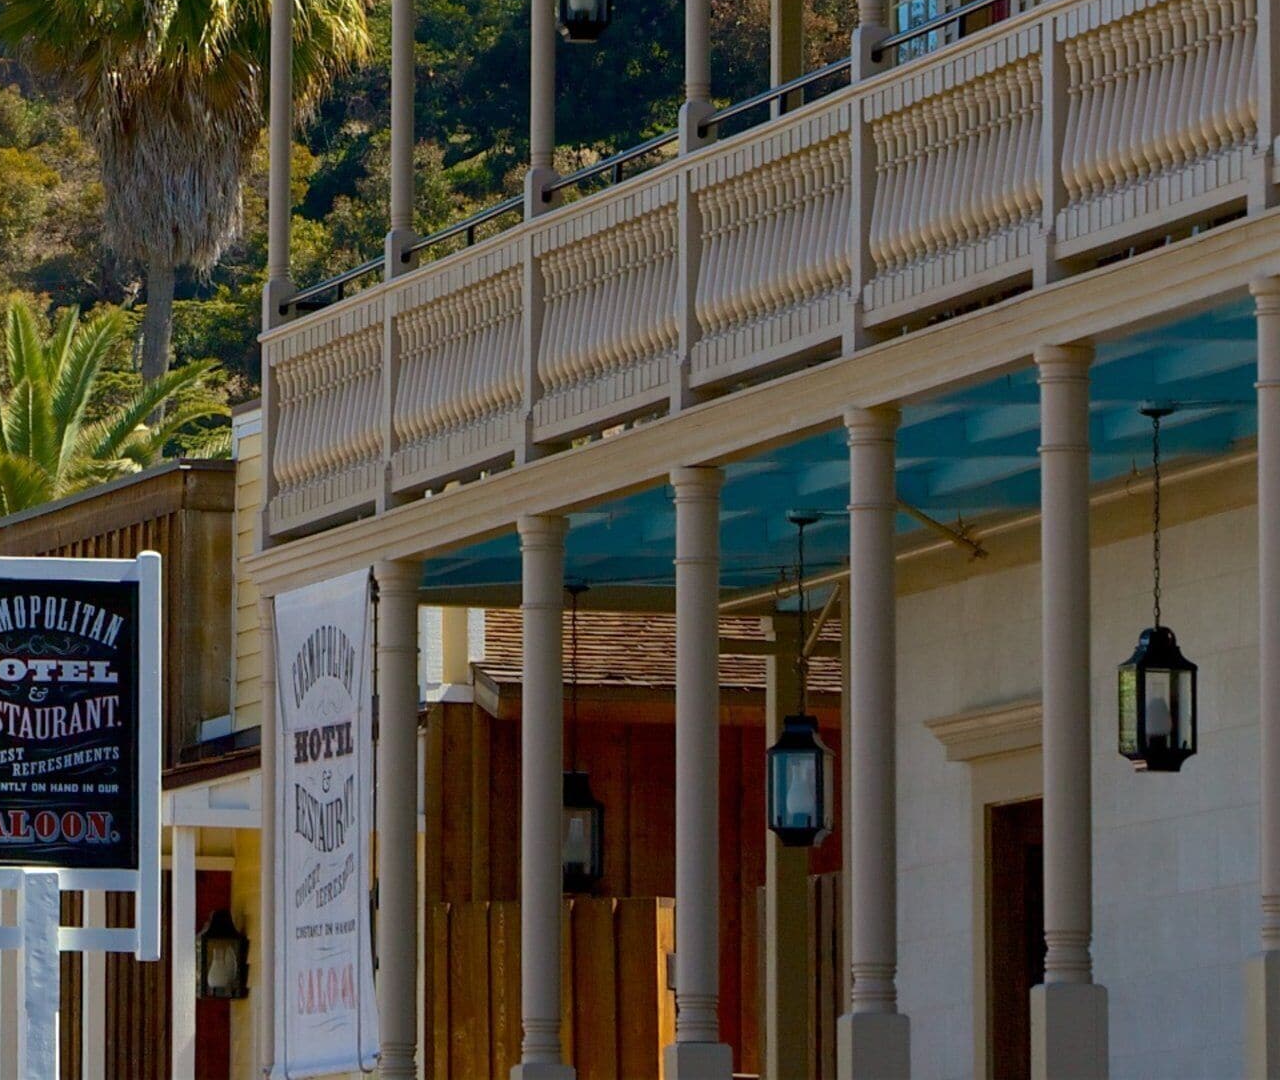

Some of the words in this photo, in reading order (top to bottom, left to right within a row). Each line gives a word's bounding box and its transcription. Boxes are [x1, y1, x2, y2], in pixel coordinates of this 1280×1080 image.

[28, 686, 49, 702] &
[12, 745, 120, 777] REFRESHMENTS
[31, 781, 47, 793] ON
[50, 782, 79, 794] HAND
[82, 783, 95, 793] IN
[98, 783, 120, 794] OUR
